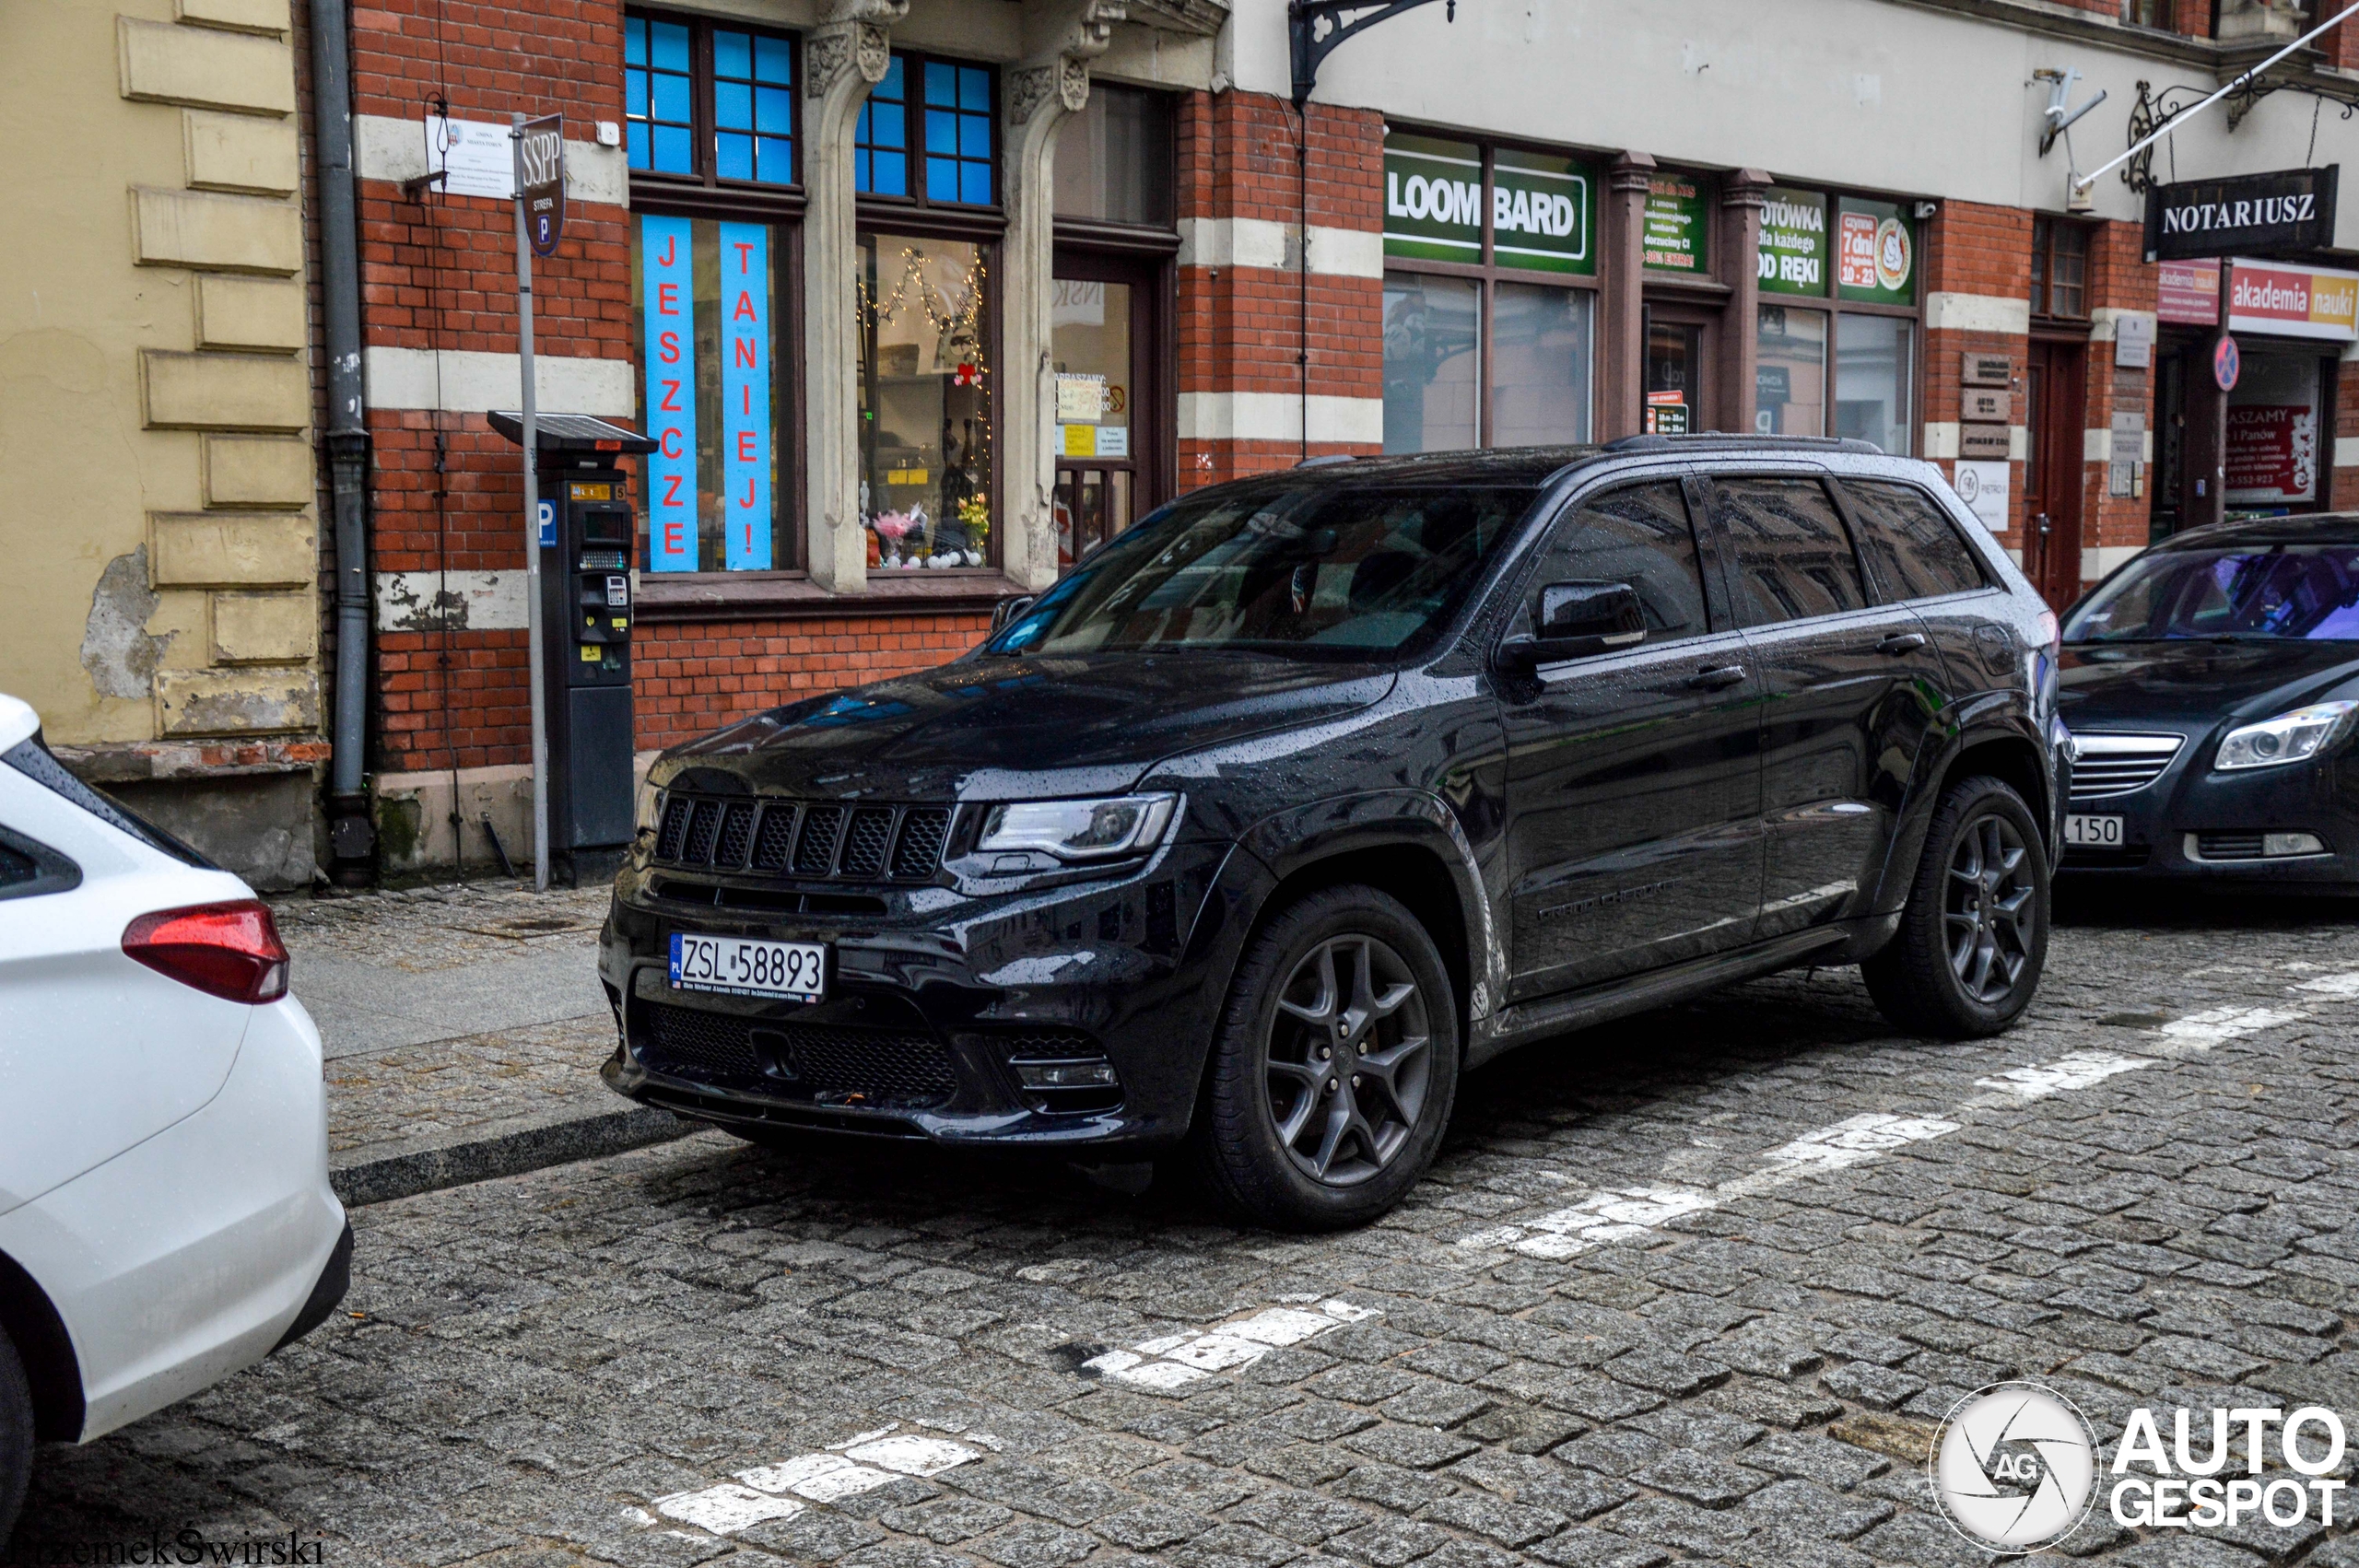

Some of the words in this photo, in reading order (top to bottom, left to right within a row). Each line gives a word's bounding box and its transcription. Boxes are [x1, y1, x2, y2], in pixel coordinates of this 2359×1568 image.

[522, 128, 560, 187] ŚSPP
[1678, 183, 1696, 198] NAS
[533, 197, 553, 211] STREFA
[1760, 195, 1824, 232] OTÓWKA
[2163, 193, 2316, 234] NOTARIUSZ
[541, 218, 549, 241] P
[1845, 216, 1873, 231] czynne
[1644, 234, 1681, 250] dorzucimy
[1774, 230, 1814, 254] każdego
[1843, 231, 1852, 253] 7
[1852, 232, 1873, 256] dni
[1646, 250, 1663, 263] 30%
[1664, 252, 1695, 268] EXTRA!
[1779, 255, 1819, 287] RĘKI
[1842, 265, 1855, 282] 10
[1861, 267, 1874, 285] 23
[2233, 277, 2307, 312] akademia
[2313, 287, 2353, 316] nauki
[658, 235, 685, 555] JESZCZE
[734, 241, 757, 554] TANIEJ!
[2228, 408, 2288, 424] ASZAMY
[2240, 428, 2276, 440] Panów
[617, 486, 624, 498] 5
[537, 503, 553, 539] P
[2073, 817, 2118, 842] 150
[1536, 896, 1595, 920] GRAND
[1599, 877, 1683, 906] CHEROKEE
[671, 962, 681, 974] PL
[683, 940, 727, 981] ZSL
[737, 944, 820, 989] 58893
